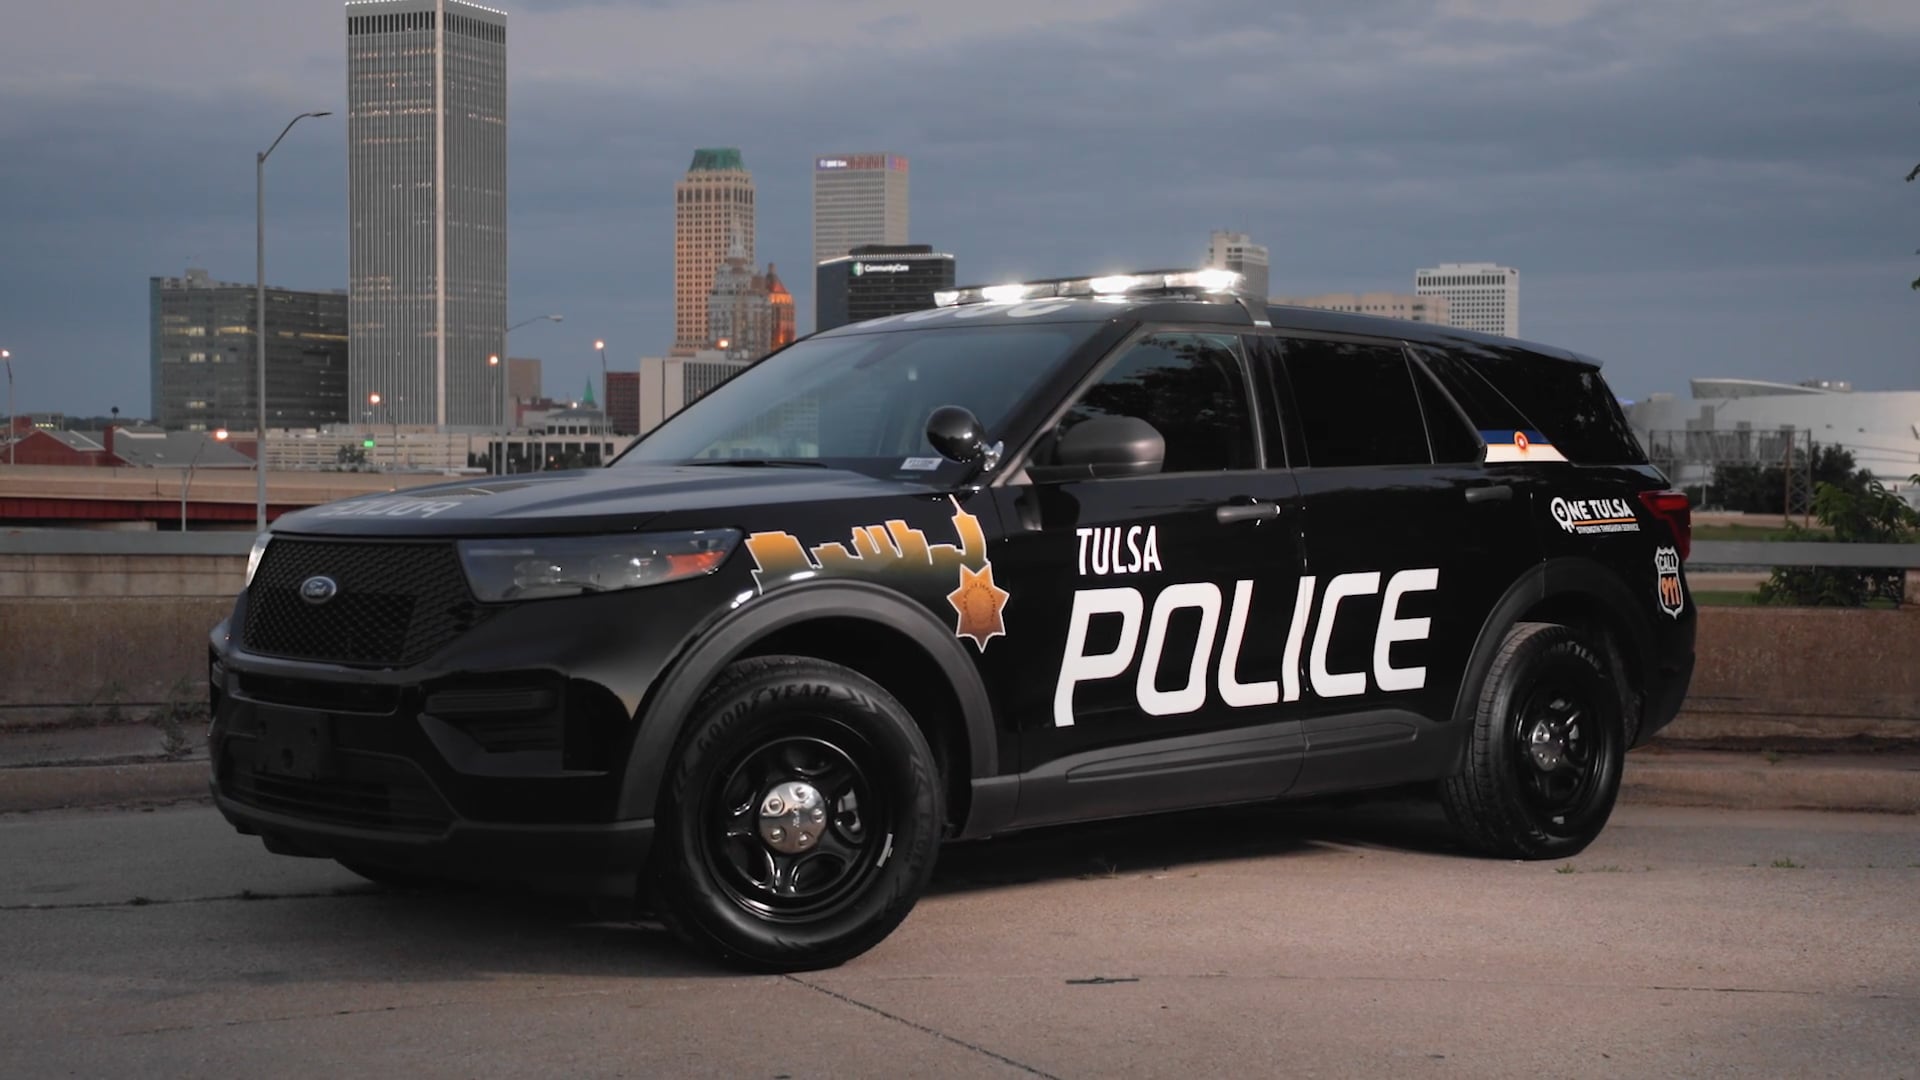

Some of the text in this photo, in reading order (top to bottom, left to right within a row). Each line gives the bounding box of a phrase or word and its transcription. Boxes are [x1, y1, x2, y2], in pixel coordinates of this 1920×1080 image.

[1588, 498, 1635, 519] TULSA
[1076, 525, 1163, 575] TULSA
[1658, 555, 1676, 570] CALL
[1661, 577, 1681, 606] 911
[1053, 568, 1440, 727] POLICE
